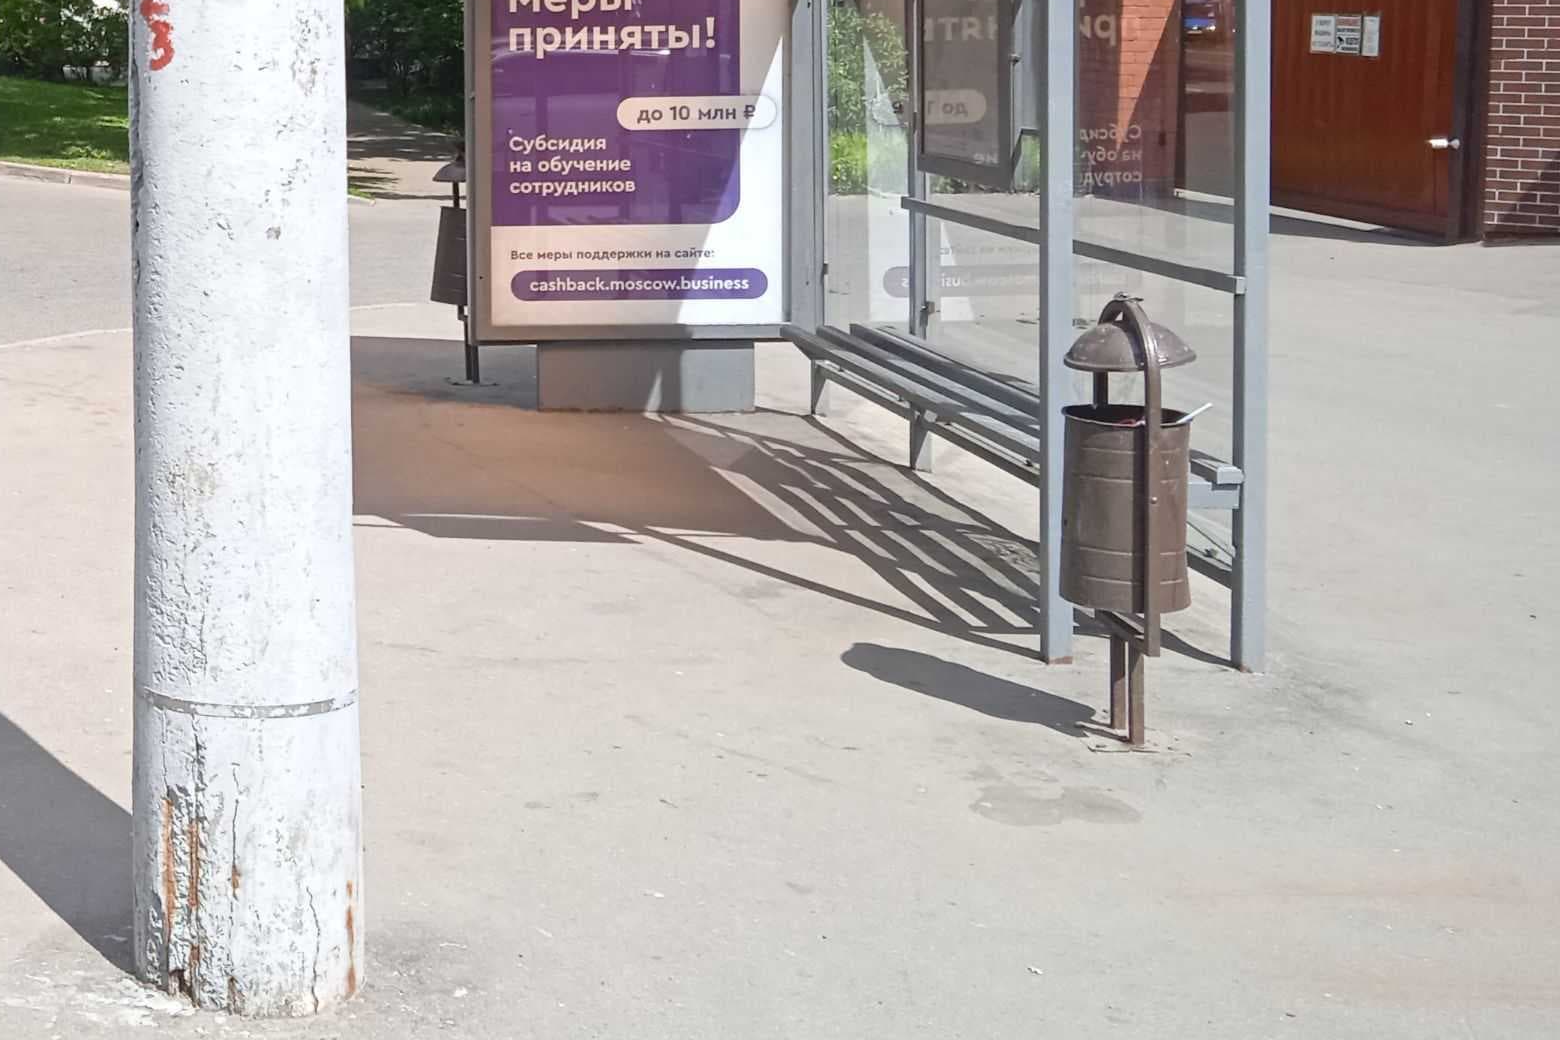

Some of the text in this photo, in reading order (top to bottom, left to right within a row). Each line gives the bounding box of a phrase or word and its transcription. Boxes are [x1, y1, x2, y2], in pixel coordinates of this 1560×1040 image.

[509, 17, 716, 59] приняты!
[637, 107, 663, 124] до
[670, 106, 690, 121] 10
[698, 107, 737, 121] млн
[509, 136, 607, 155] Субсидия
[510, 157, 631, 176] на обучение
[510, 179, 636, 197] сотрудников
[511, 248, 716, 262] Все меры поддержки на сайте:
[529, 275, 750, 292] cashback.moscow.business
